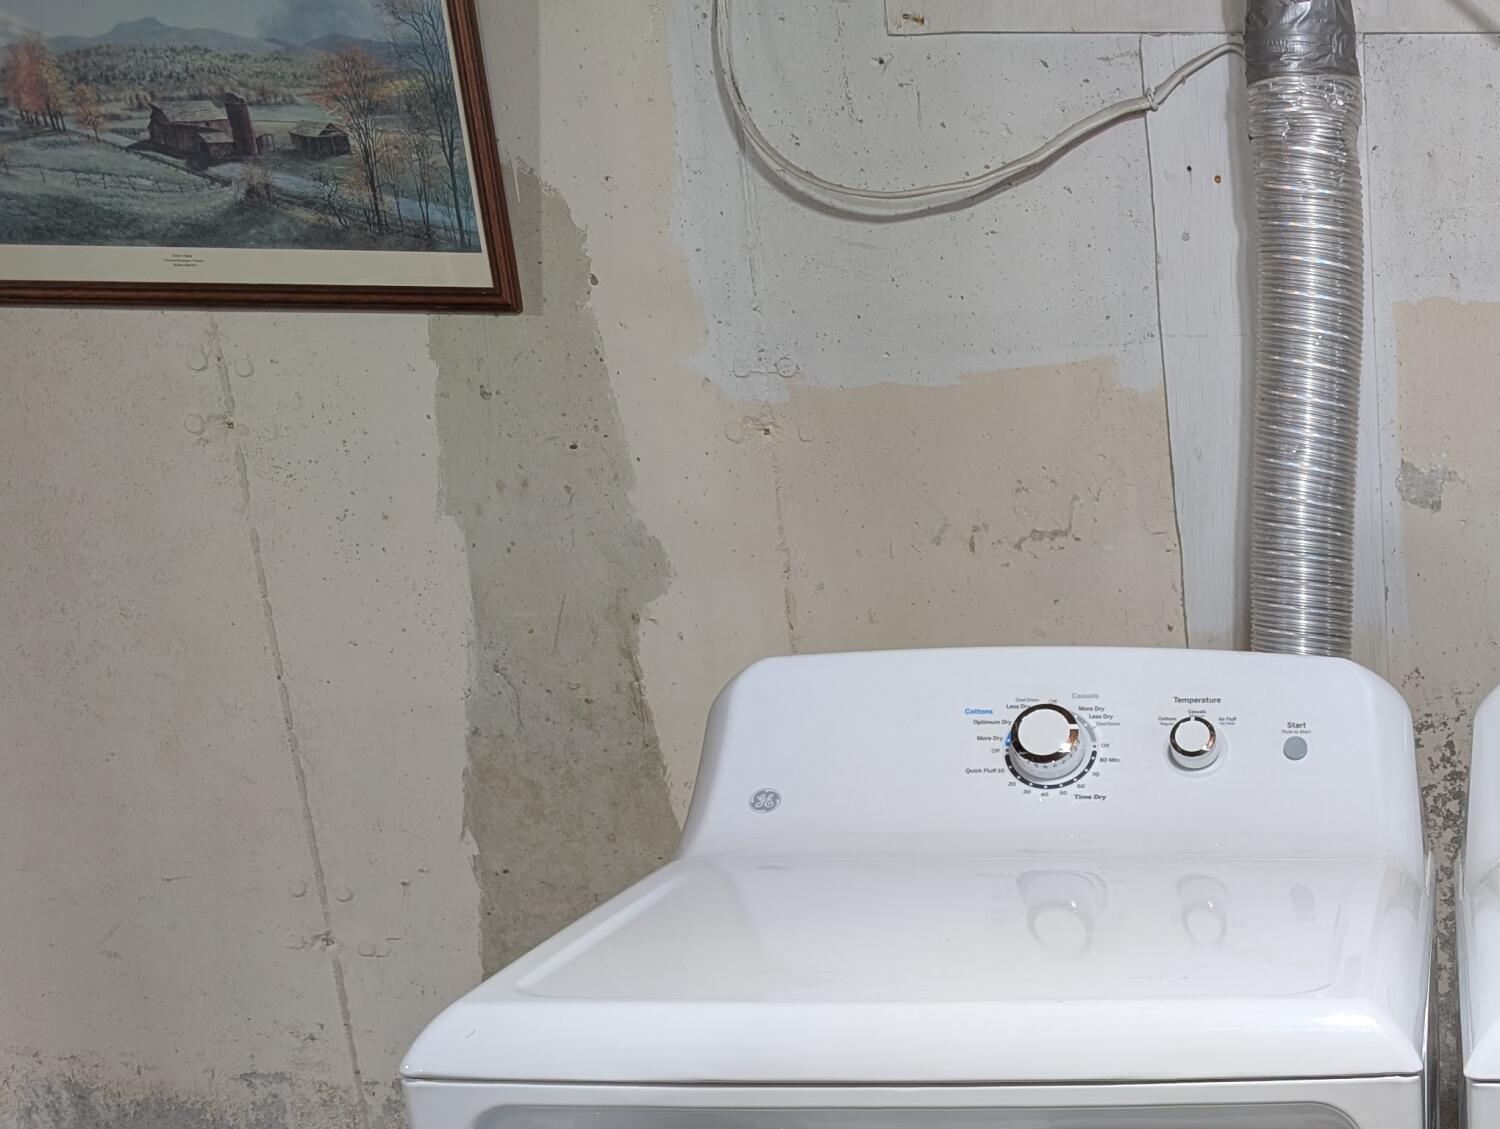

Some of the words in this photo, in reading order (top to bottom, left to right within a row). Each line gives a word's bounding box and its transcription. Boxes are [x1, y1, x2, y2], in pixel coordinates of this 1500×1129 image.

[1173, 696, 1221, 704] Temperature
[1094, 705, 1105, 713] Dry
[1093, 793, 1106, 801] Dry
